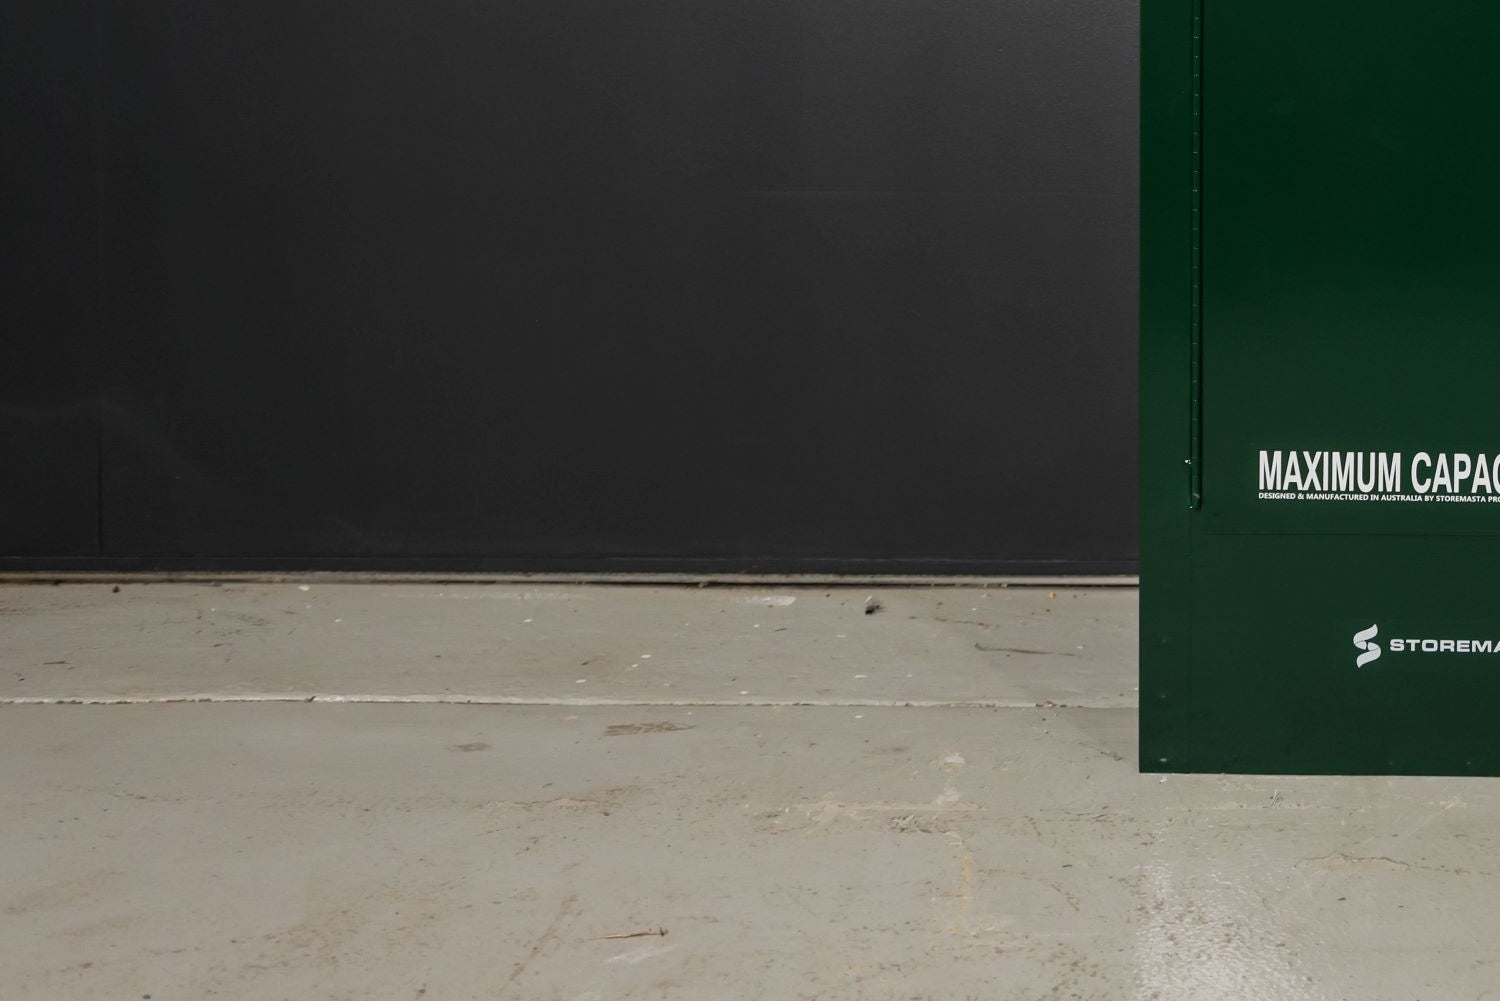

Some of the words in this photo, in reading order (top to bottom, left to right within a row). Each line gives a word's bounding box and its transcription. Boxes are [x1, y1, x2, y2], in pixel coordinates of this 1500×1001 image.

[1259, 451, 1401, 492] MAXIMUM
[1258, 492, 1296, 500] DESIGNED
[1306, 493, 1369, 501] MANUFACTURED
[1381, 494, 1422, 502] AUSTRALIA
[1436, 495, 1486, 503] STOREMASTA
